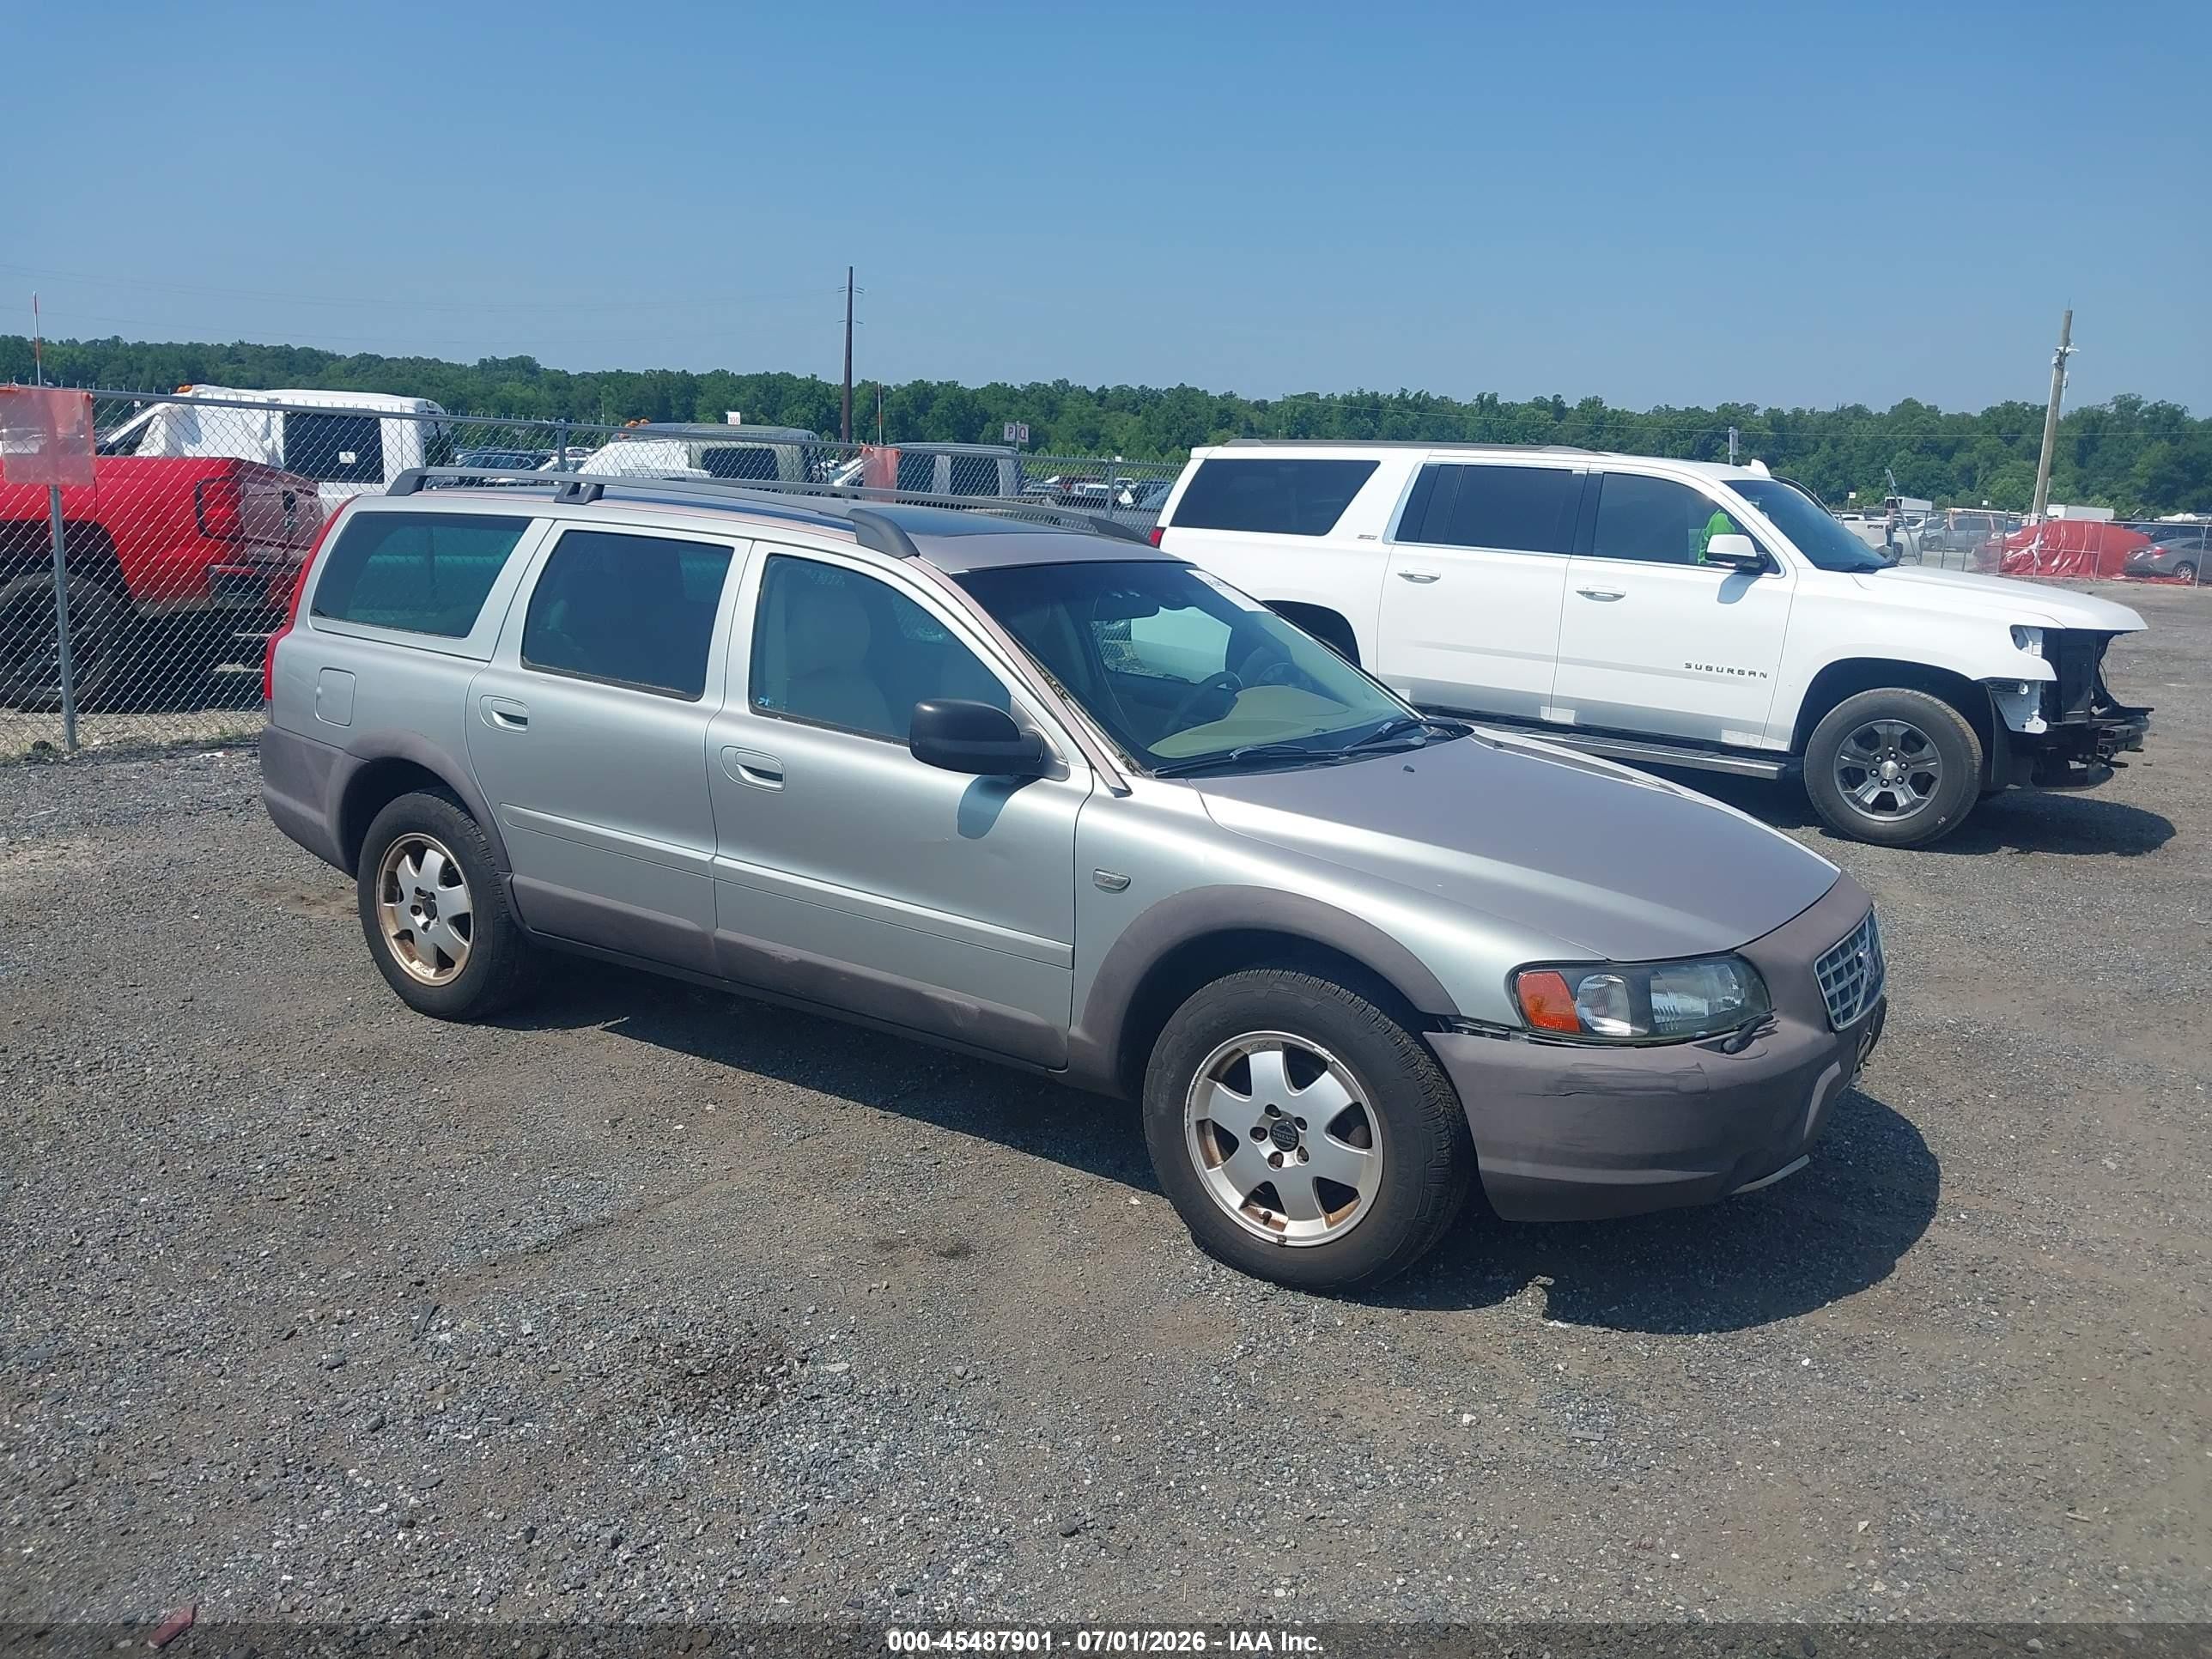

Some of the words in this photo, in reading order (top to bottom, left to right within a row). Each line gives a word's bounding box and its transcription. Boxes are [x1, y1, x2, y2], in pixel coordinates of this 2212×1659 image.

[1008, 426, 1014, 438] P
[1019, 427, 1027, 441] Q
[1684, 662, 1768, 678] SUBURBAN
[1273, 1130, 1297, 1143] VOLVO
